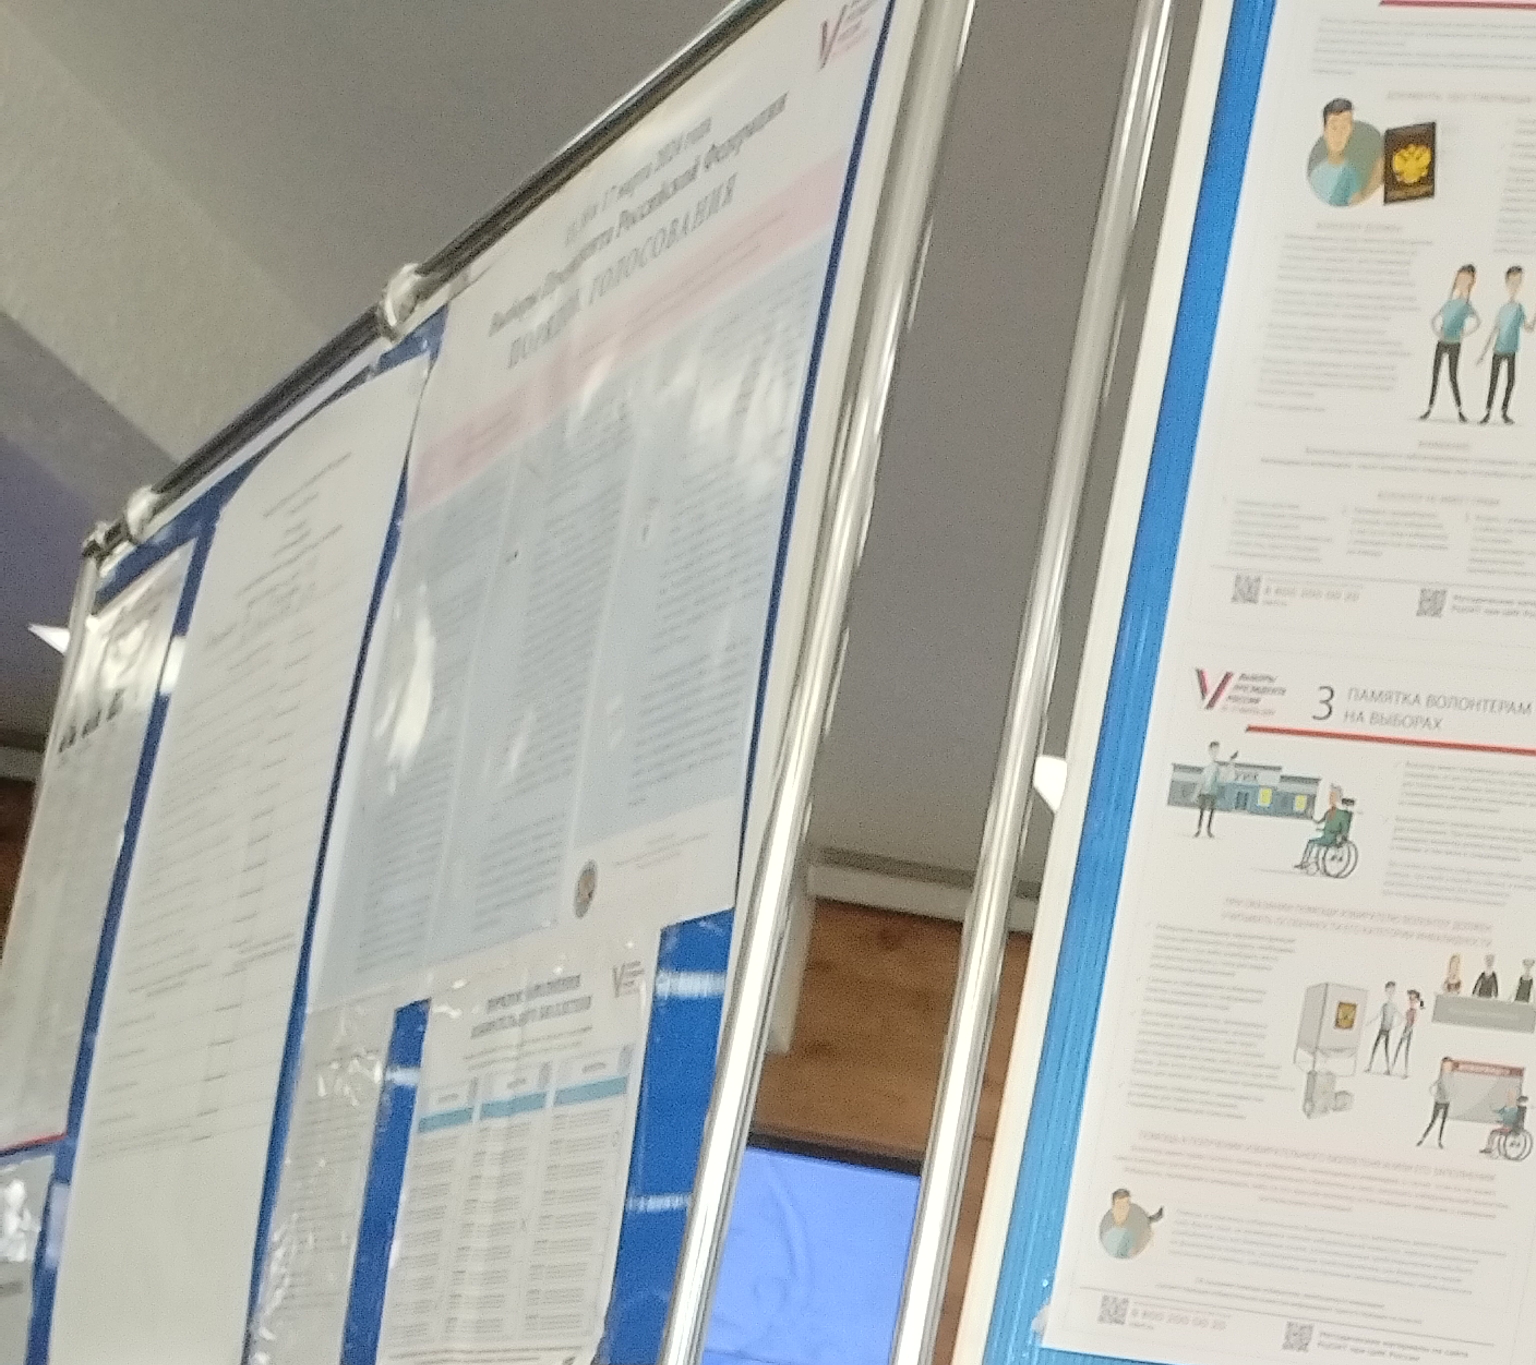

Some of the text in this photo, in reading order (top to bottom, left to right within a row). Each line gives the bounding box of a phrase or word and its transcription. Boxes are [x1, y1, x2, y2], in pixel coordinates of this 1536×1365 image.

[1312, 685, 1335, 721] 3
[1346, 686, 1533, 716] ПАМЯТКА ВОЛОНТЕРАМ
[1342, 710, 1444, 731] НА ВЫБОРАХ
